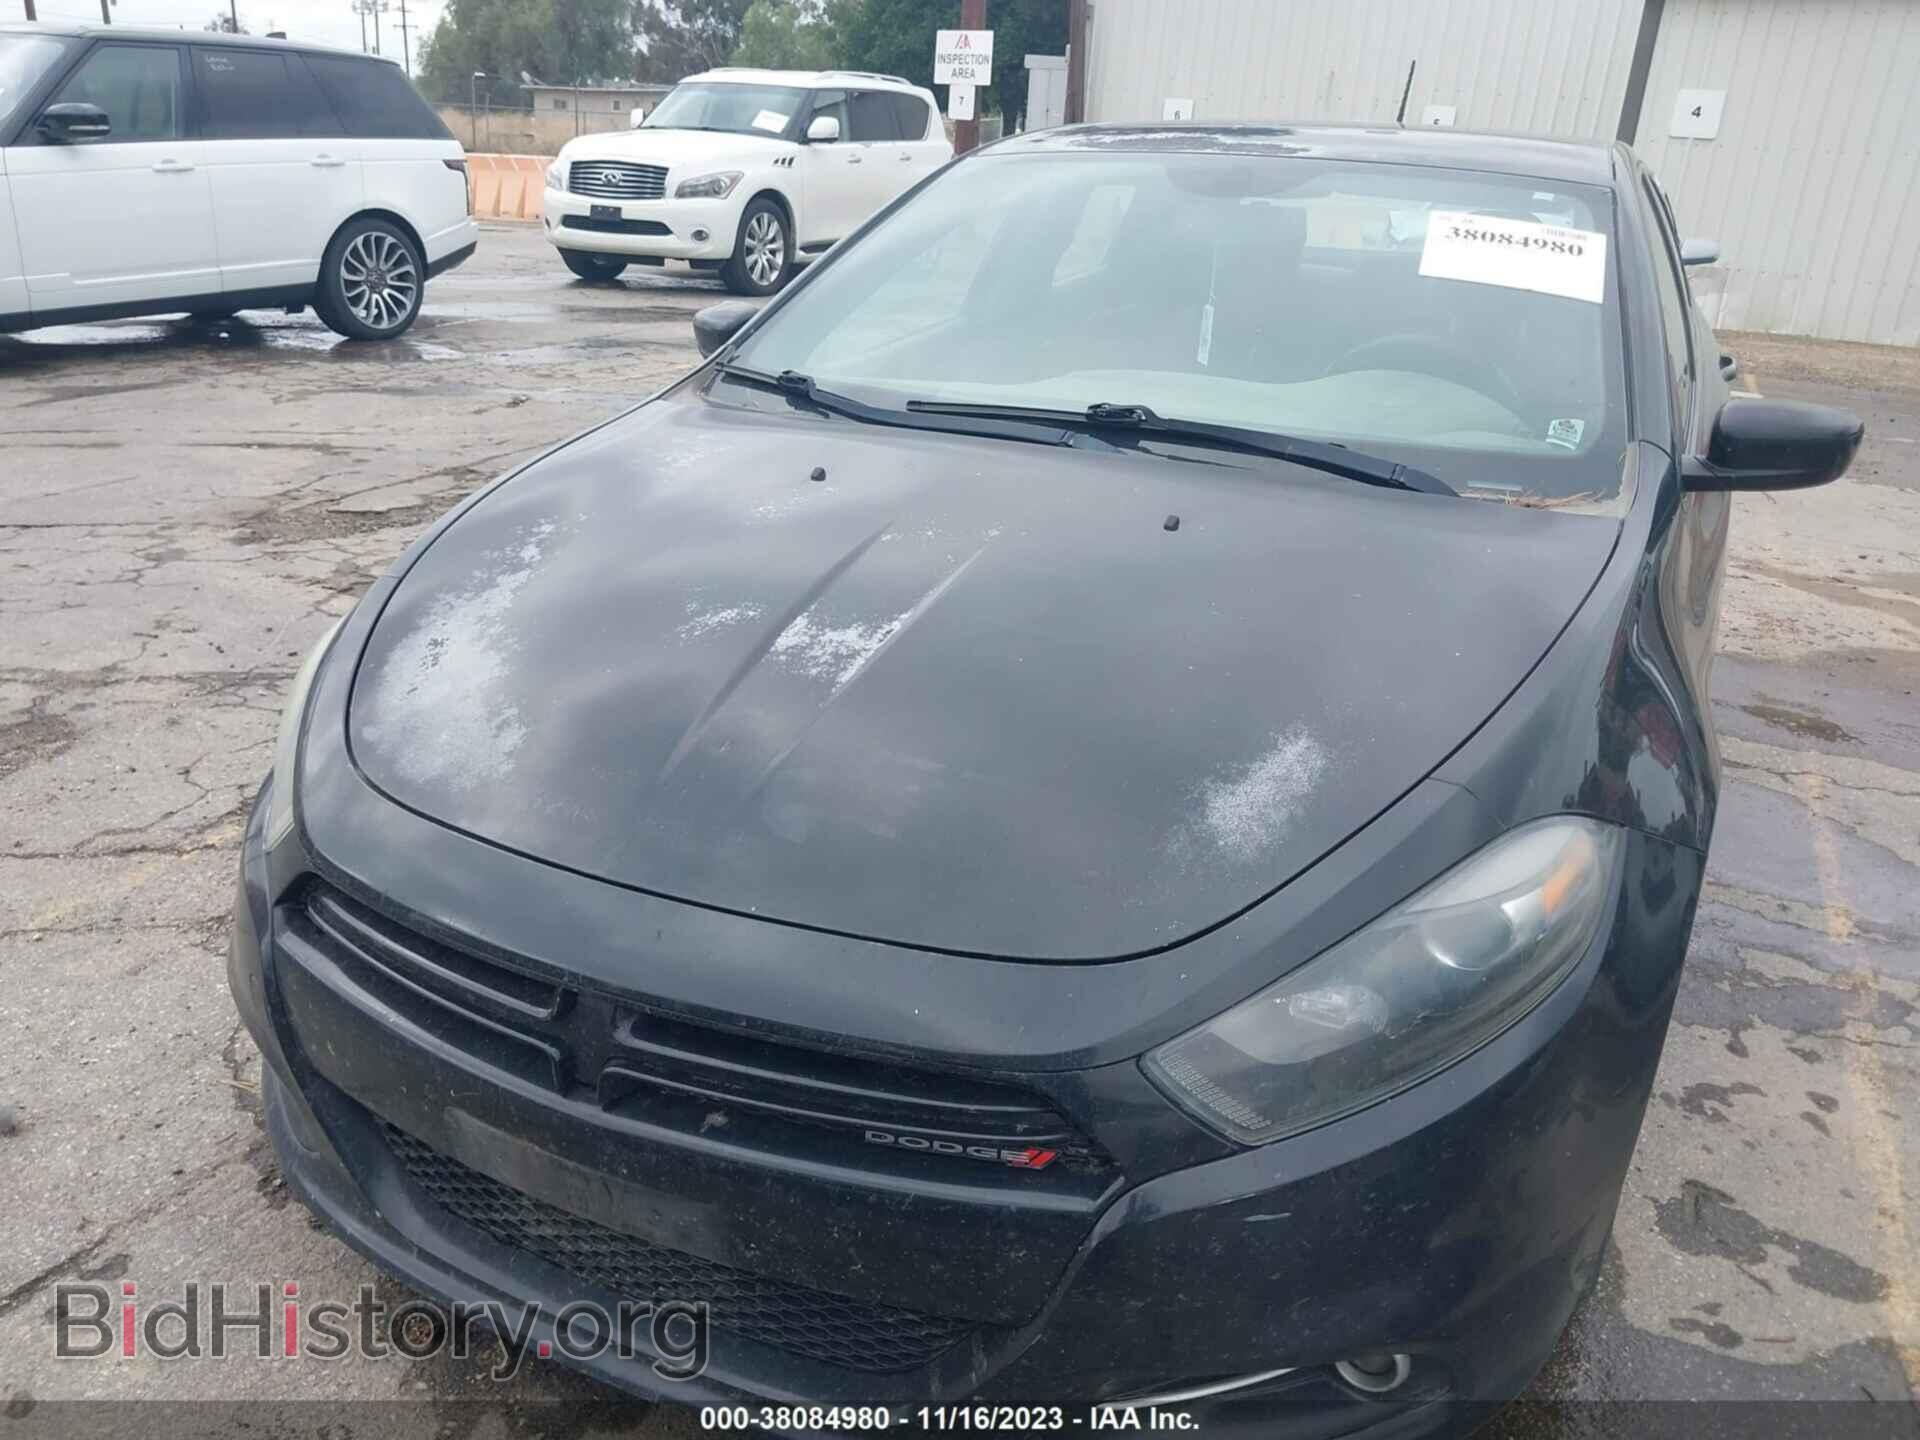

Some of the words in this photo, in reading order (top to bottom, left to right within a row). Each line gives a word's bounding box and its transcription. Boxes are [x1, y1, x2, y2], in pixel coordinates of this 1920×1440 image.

[937, 53, 990, 65] INSPECTION
[951, 67, 976, 79] AREA
[958, 95, 965, 106] 7
[1691, 105, 1702, 118] 4
[1444, 226, 1584, 257] 38084980
[864, 1130, 1031, 1164] DODGE
